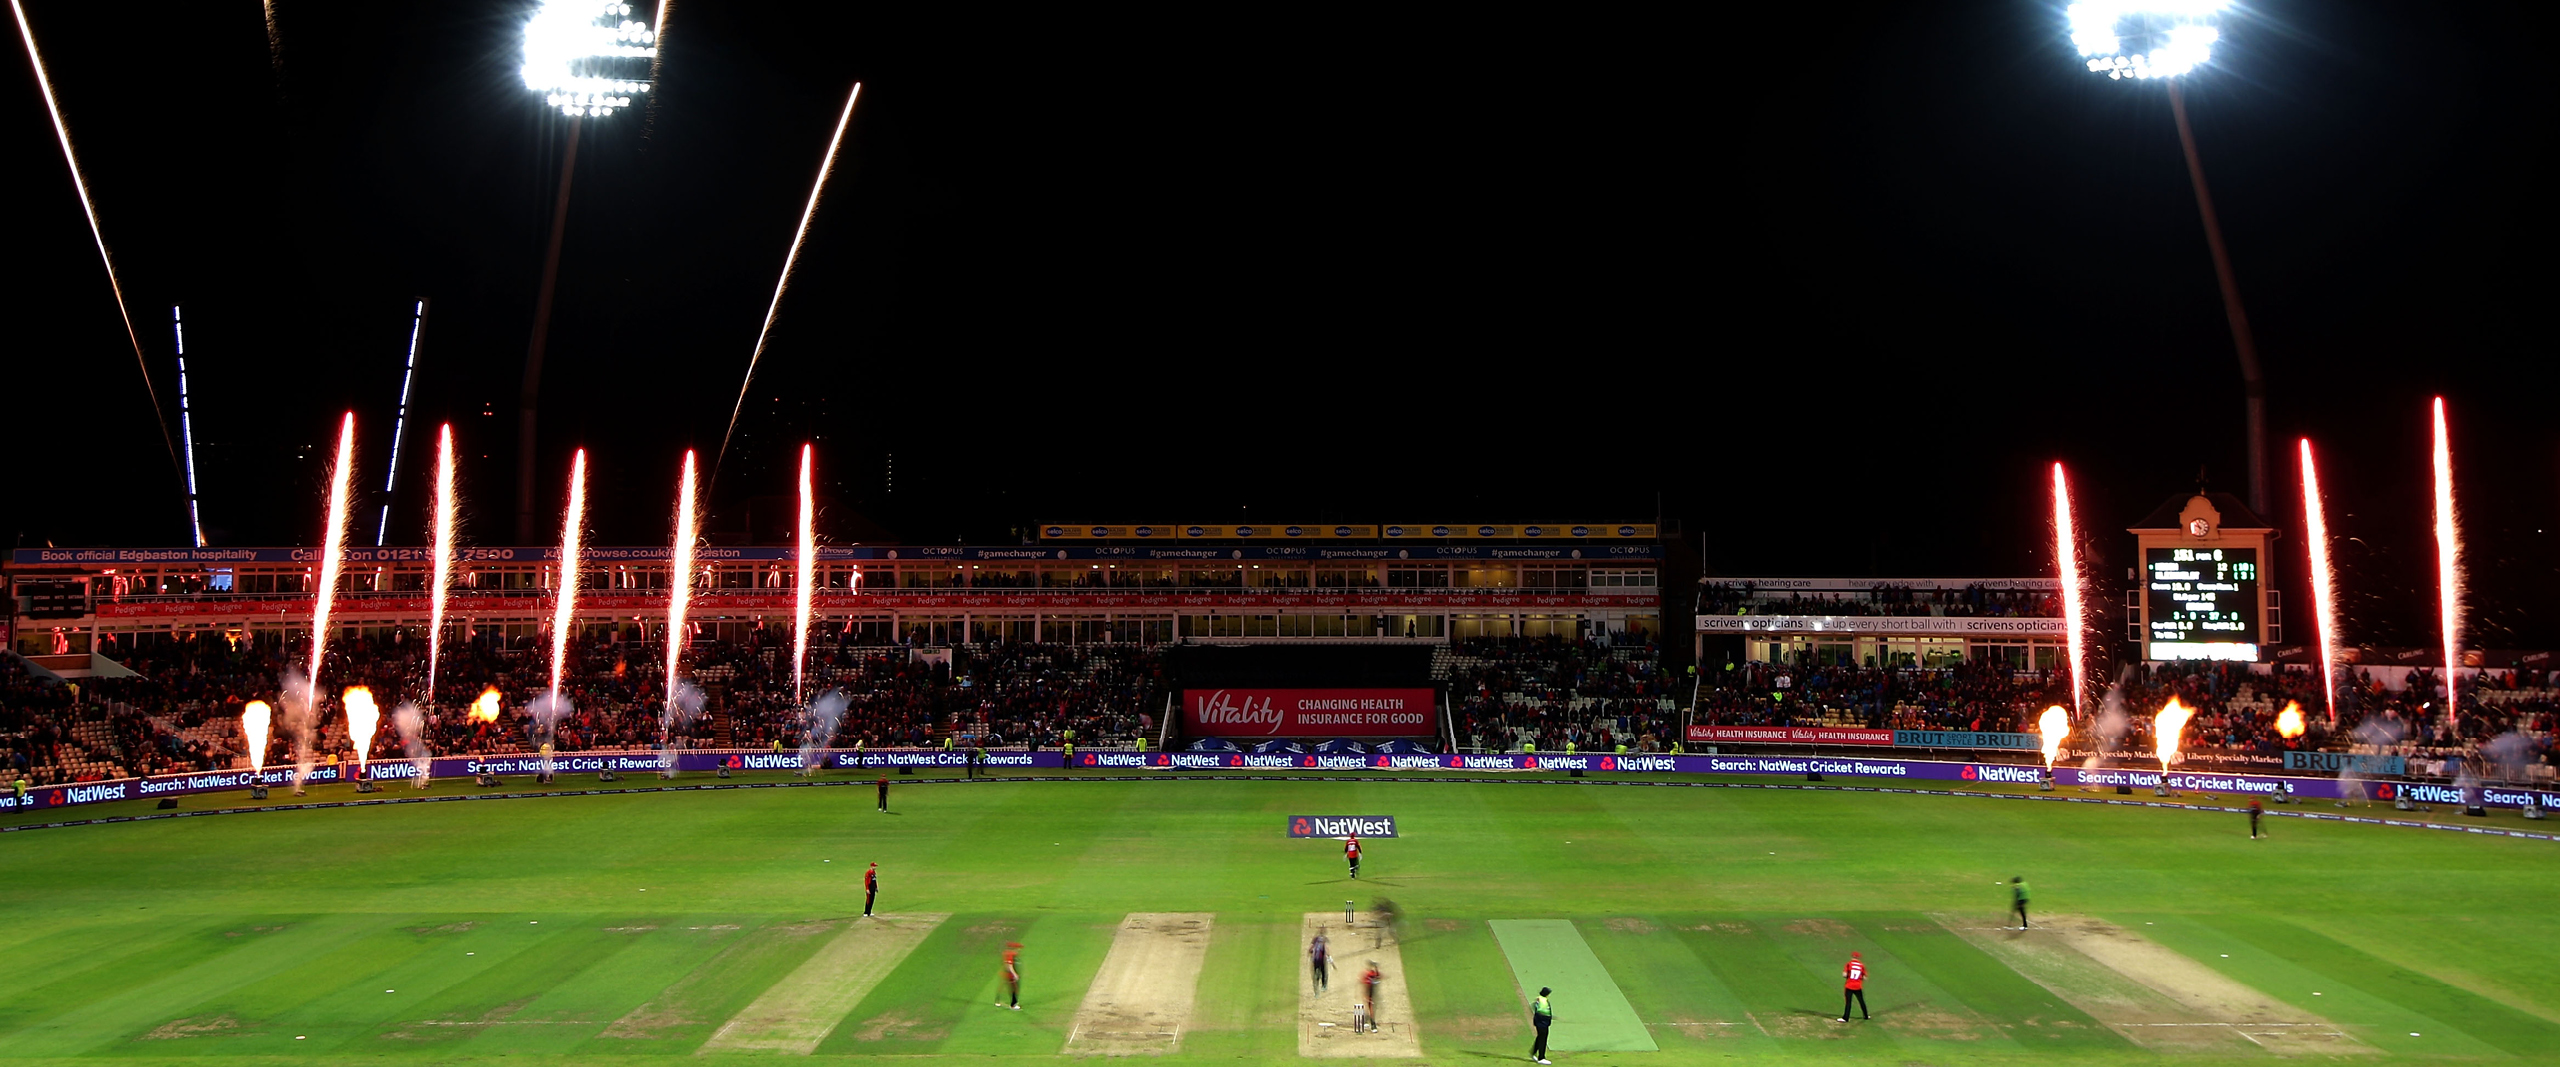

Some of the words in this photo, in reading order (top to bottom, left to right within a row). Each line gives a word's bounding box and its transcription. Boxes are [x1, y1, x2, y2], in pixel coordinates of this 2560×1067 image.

[291, 549, 322, 560] Call
[351, 551, 372, 560] on
[377, 549, 419, 560] 0121
[922, 547, 964, 555] OCTOPUS
[977, 550, 1047, 560] #gamechanger
[1094, 547, 1136, 555] OCTOPUS
[1149, 549, 1218, 559] #gamechanger
[1265, 547, 1307, 555] OCTOPUS
[1320, 549, 1389, 559] #gamechanger
[1491, 549, 1561, 559] #gamechanger
[1609, 546, 1651, 554] OCTOPUS
[41, 551, 73, 561] Book
[76, 550, 116, 561] official
[119, 550, 188, 563] Edgbaston
[191, 549, 257, 562] hospitality
[1758, 579, 1791, 589] hearing
[1849, 579, 1867, 587] hear
[1916, 579, 1934, 587] with
[1973, 579, 2008, 588] scrivens
[2009, 579, 2043, 589] hearing
[361, 600, 390, 610] Pedigree
[456, 598, 485, 608] Pedigree
[504, 597, 533, 607] Pedigree
[598, 597, 627, 606] Pedigree
[736, 596, 765, 606] Pedigree
[827, 596, 855, 605] Pedigree
[873, 596, 901, 605] Pedigree
[918, 596, 946, 605] Pedigree
[962, 596, 991, 605] Pedigree
[1007, 596, 1035, 605] Pedigree
[1052, 596, 1080, 605] Pedigree
[1096, 596, 1124, 605] Pedigree
[1140, 596, 1168, 605] Pedigree
[1184, 596, 1212, 605] Pedigree
[1228, 596, 1256, 605] Pedigree
[1272, 596, 1300, 605] Pedigree
[1316, 596, 1344, 605] Pedigree
[1360, 596, 1388, 605] Pedigree
[1404, 596, 1432, 605] Pedigree
[1448, 596, 1476, 605] Pedigree
[1492, 596, 1520, 605] Pedigree
[1536, 596, 1565, 605] Pedigree
[1581, 596, 1610, 605] Pedigree
[1626, 596, 1655, 605] Pedigree
[115, 606, 146, 615] Pedigree
[165, 604, 195, 614] Pedigree
[213, 603, 242, 612] Pedigree
[261, 602, 293, 611] Pedigree
[1752, 618, 1803, 631] opticians
[1832, 620, 1846, 630] up
[1848, 620, 1879, 631] every
[1881, 619, 1909, 629] short
[1911, 619, 1930, 630] ball
[1932, 619, 1956, 630] with
[1967, 620, 2014, 631] scrivens
[1298, 699, 1357, 710] CHANGING
[1360, 699, 1404, 710] HEALTH
[1198, 689, 1284, 735] Vitality
[1298, 713, 1363, 724] INSURANCE
[1365, 713, 1389, 724] FOR
[1390, 713, 1424, 724] GOOD
[1690, 726, 1715, 739] Vitality
[1716, 729, 1744, 738] HEALTH
[1745, 730, 1787, 739] INSURANCE
[1791, 727, 1817, 741] Vitality
[1818, 731, 1846, 740] HEALTH
[1847, 731, 1890, 742] INSURANCE
[1897, 732, 1945, 745] BRUT
[1975, 734, 2023, 747] BRUT
[887, 753, 936, 765] NatWest
[938, 753, 981, 765] Crickt
[983, 753, 1033, 765] Rewards
[1098, 753, 1147, 766] NatWest
[2072, 749, 2098, 759] Liberty
[2100, 750, 2133, 760] Specialty
[2134, 751, 2157, 759] Mark
[2187, 752, 2212, 762] Liberty
[2215, 753, 2250, 764] Specialty
[2250, 755, 2283, 764] Markets
[518, 759, 569, 771] NatWest
[572, 758, 617, 769] Crickt
[619, 757, 672, 769] Rewards
[744, 754, 803, 769] NatWest
[1170, 754, 1220, 767] NatWest
[1244, 754, 1293, 768] NatWest
[1317, 755, 1366, 768] NatWest
[1391, 755, 1440, 768] NatWest
[1464, 755, 1514, 769] NatWest
[1538, 756, 1588, 770] NatWest
[1617, 756, 1676, 772] NatWest
[2292, 752, 2356, 770] BRUT
[370, 763, 430, 779] NatWest
[1711, 758, 1757, 772] Search:
[1759, 759, 1808, 773] NatWest
[1809, 760, 1853, 774] Cricket
[1855, 761, 1907, 776] Rewards
[1978, 765, 2040, 783] NatWest
[140, 777, 185, 793] Search:
[188, 773, 237, 789] NatWest
[240, 770, 283, 785] Crket
[2077, 771, 2126, 785] Search:
[2129, 772, 2183, 788] NatWst
[2185, 775, 2234, 790] Cricket
[67, 784, 126, 804] NatWest
[1314, 817, 1392, 835] NatWest
